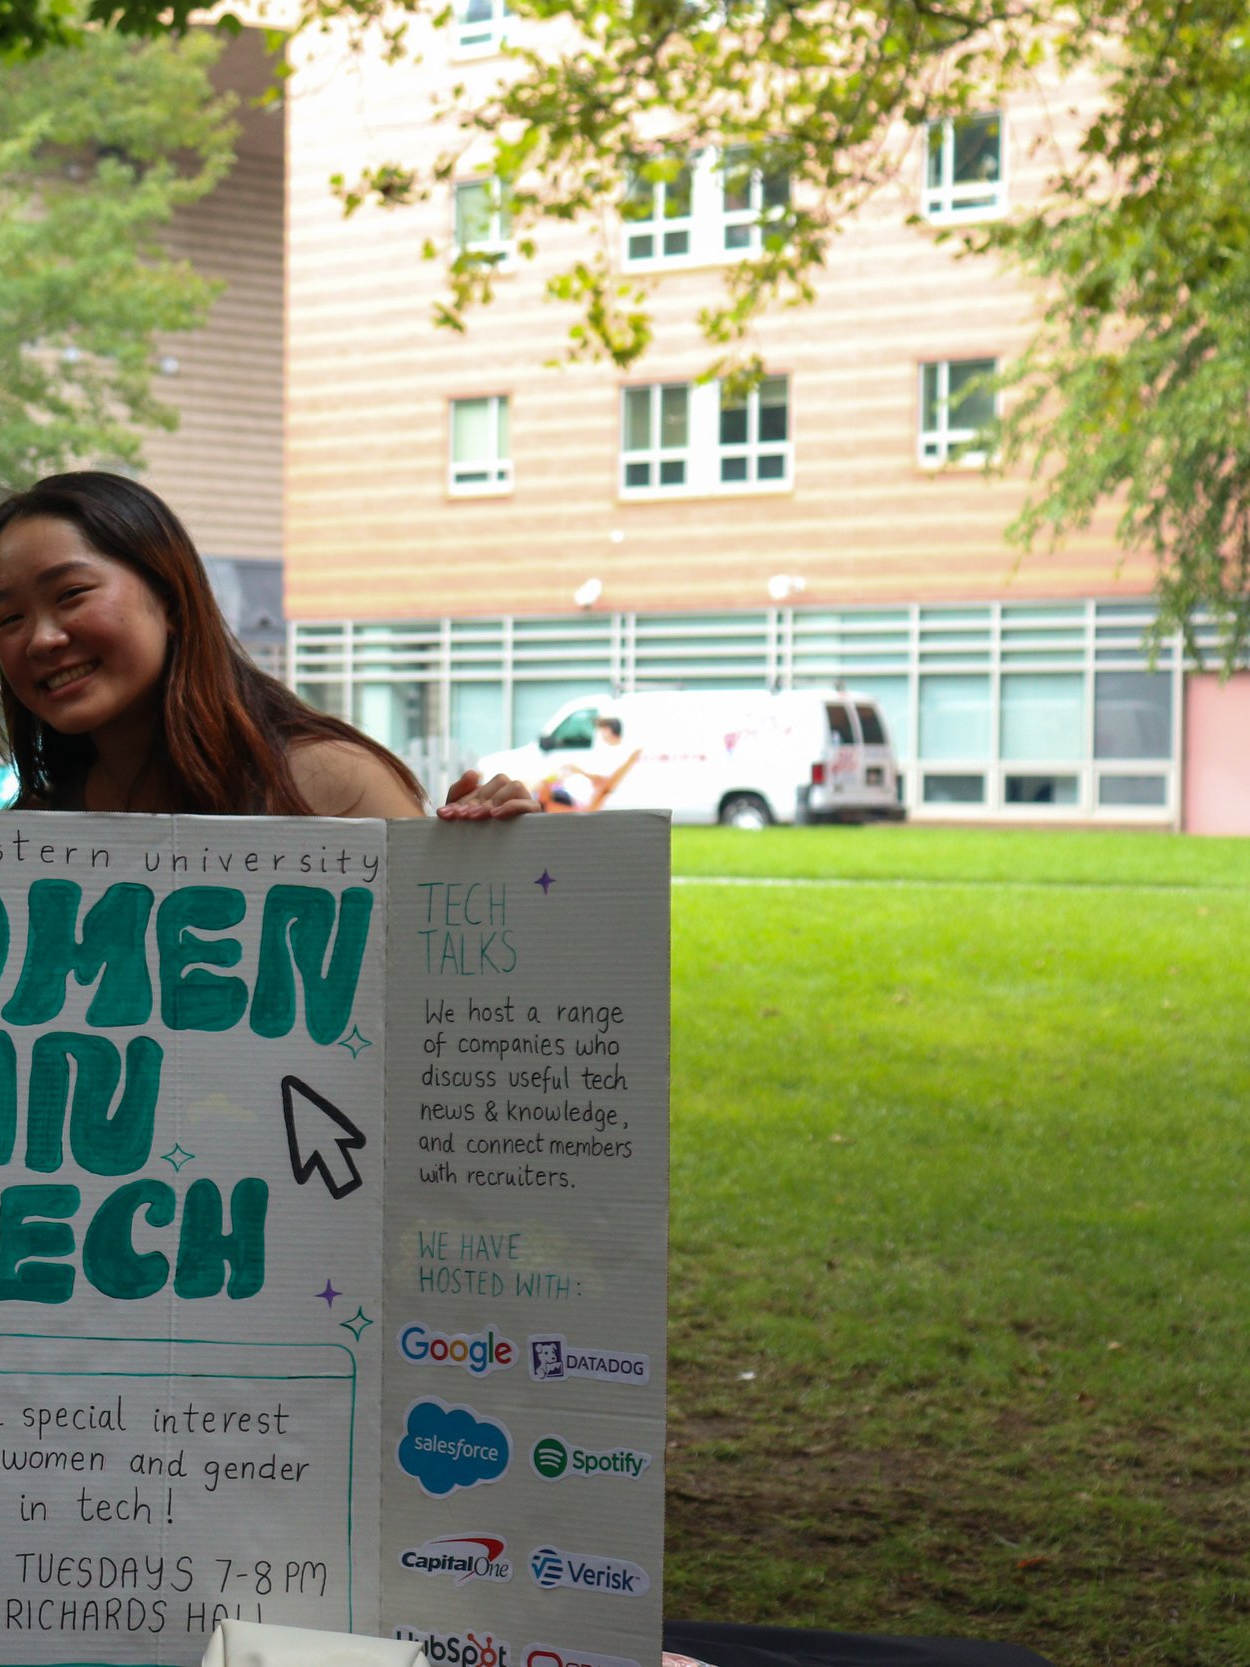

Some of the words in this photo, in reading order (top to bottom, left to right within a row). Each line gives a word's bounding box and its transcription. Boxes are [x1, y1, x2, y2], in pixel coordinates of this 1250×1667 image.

[144, 845, 381, 883] university
[417, 882, 507, 926] TECH
[417, 929, 517, 976] TALKS
[425, 999, 455, 1025] We
[468, 996, 515, 1024] host
[527, 1007, 542, 1024] a
[557, 1003, 625, 1034] range
[423, 1031, 446, 1058] of
[458, 1033, 566, 1061] companies
[576, 1034, 620, 1056] who
[422, 1064, 496, 1088] discuss
[509, 1065, 570, 1094] useful
[581, 1062, 628, 1091] tech
[420, 1101, 476, 1121] news
[485, 1100, 499, 1122] &
[507, 1100, 629, 1132] knowledge,
[419, 1132, 455, 1153] and
[467, 1133, 545, 1154] connect
[550, 1135, 633, 1159] members
[420, 1162, 457, 1184] with
[467, 1166, 576, 1189] recruiters.
[419, 1231, 449, 1260] WE
[461, 1233, 521, 1261] HAVE
[419, 1266, 505, 1297] HOSTED
[516, 1272, 582, 1299] WITH:
[401, 1327, 512, 1373] Google
[566, 1355, 644, 1376] DATADOG
[22, 1395, 127, 1440] special
[154, 1403, 290, 1435] interest
[414, 1434, 499, 1461] salesforce
[572, 1450, 643, 1477] Spotify
[2, 1448, 105, 1472] women
[130, 1449, 188, 1478] and
[204, 1453, 310, 1492] gender
[21, 1494, 48, 1522] in
[15, 1553, 193, 1592] TUESDAYS
[6, 1597, 167, 1633] RICHARDS
